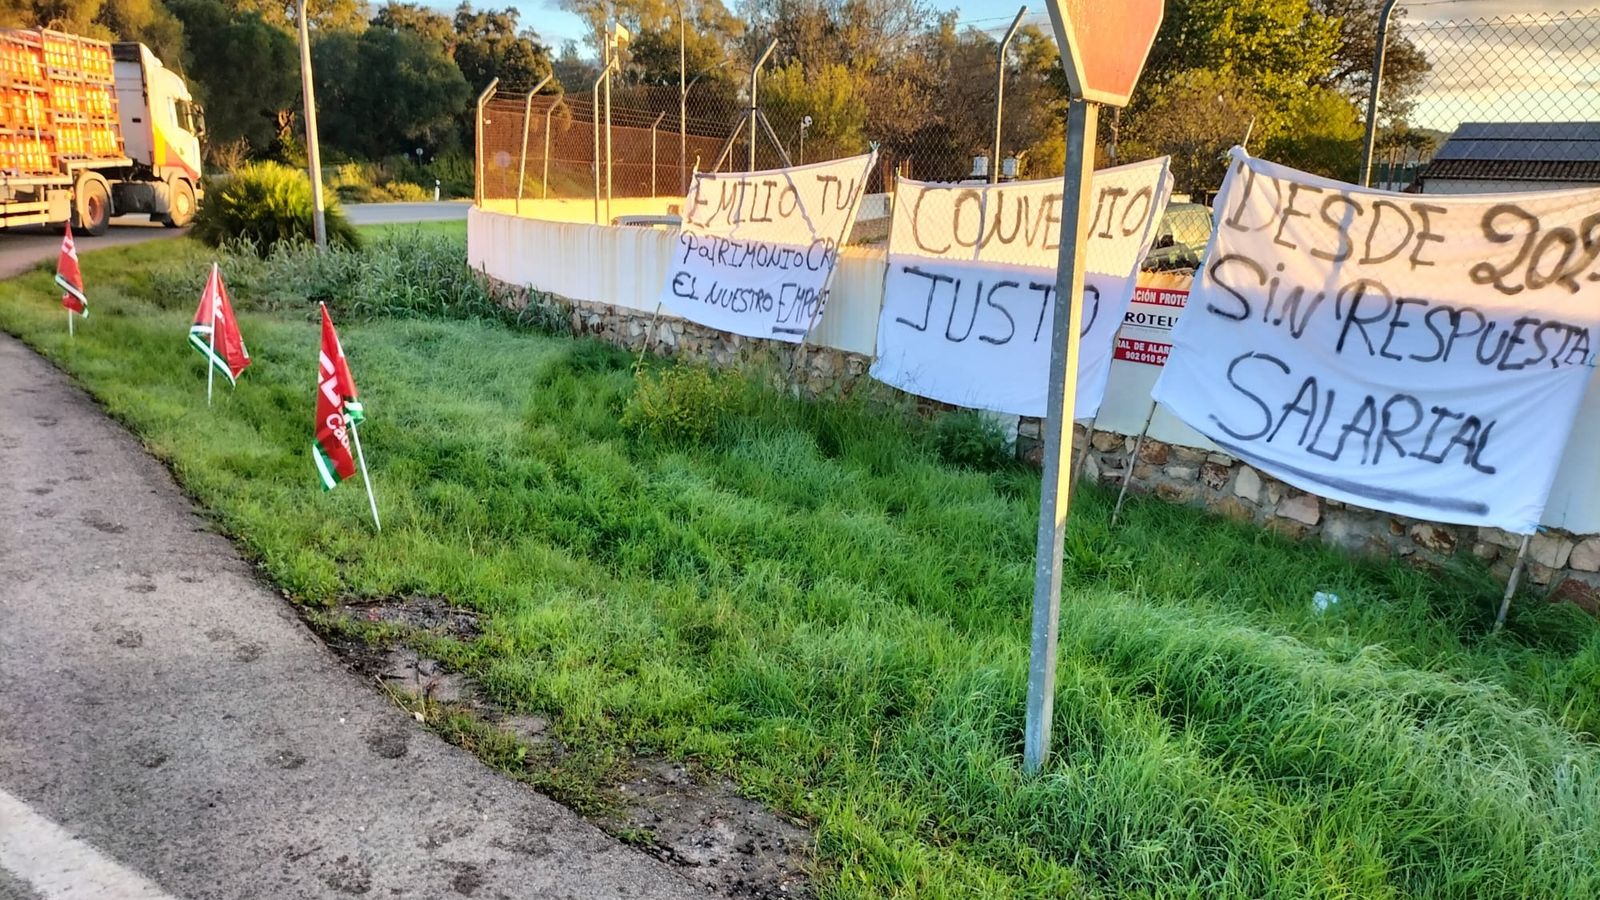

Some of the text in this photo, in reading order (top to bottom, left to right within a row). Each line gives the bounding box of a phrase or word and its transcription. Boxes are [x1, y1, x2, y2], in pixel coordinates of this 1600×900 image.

[687, 173, 855, 228] EMILIO TU
[914, 185, 1152, 254] CONVEIO
[1225, 160, 1448, 268] DESDE
[673, 272, 700, 301] EL
[704, 281, 774, 313] NUESTRO
[1335, 277, 1590, 370] RESPUESTA
[1125, 350, 1140, 361] 902
[1134, 342, 1145, 352] DE
[1208, 351, 1497, 475] SALARIAL
